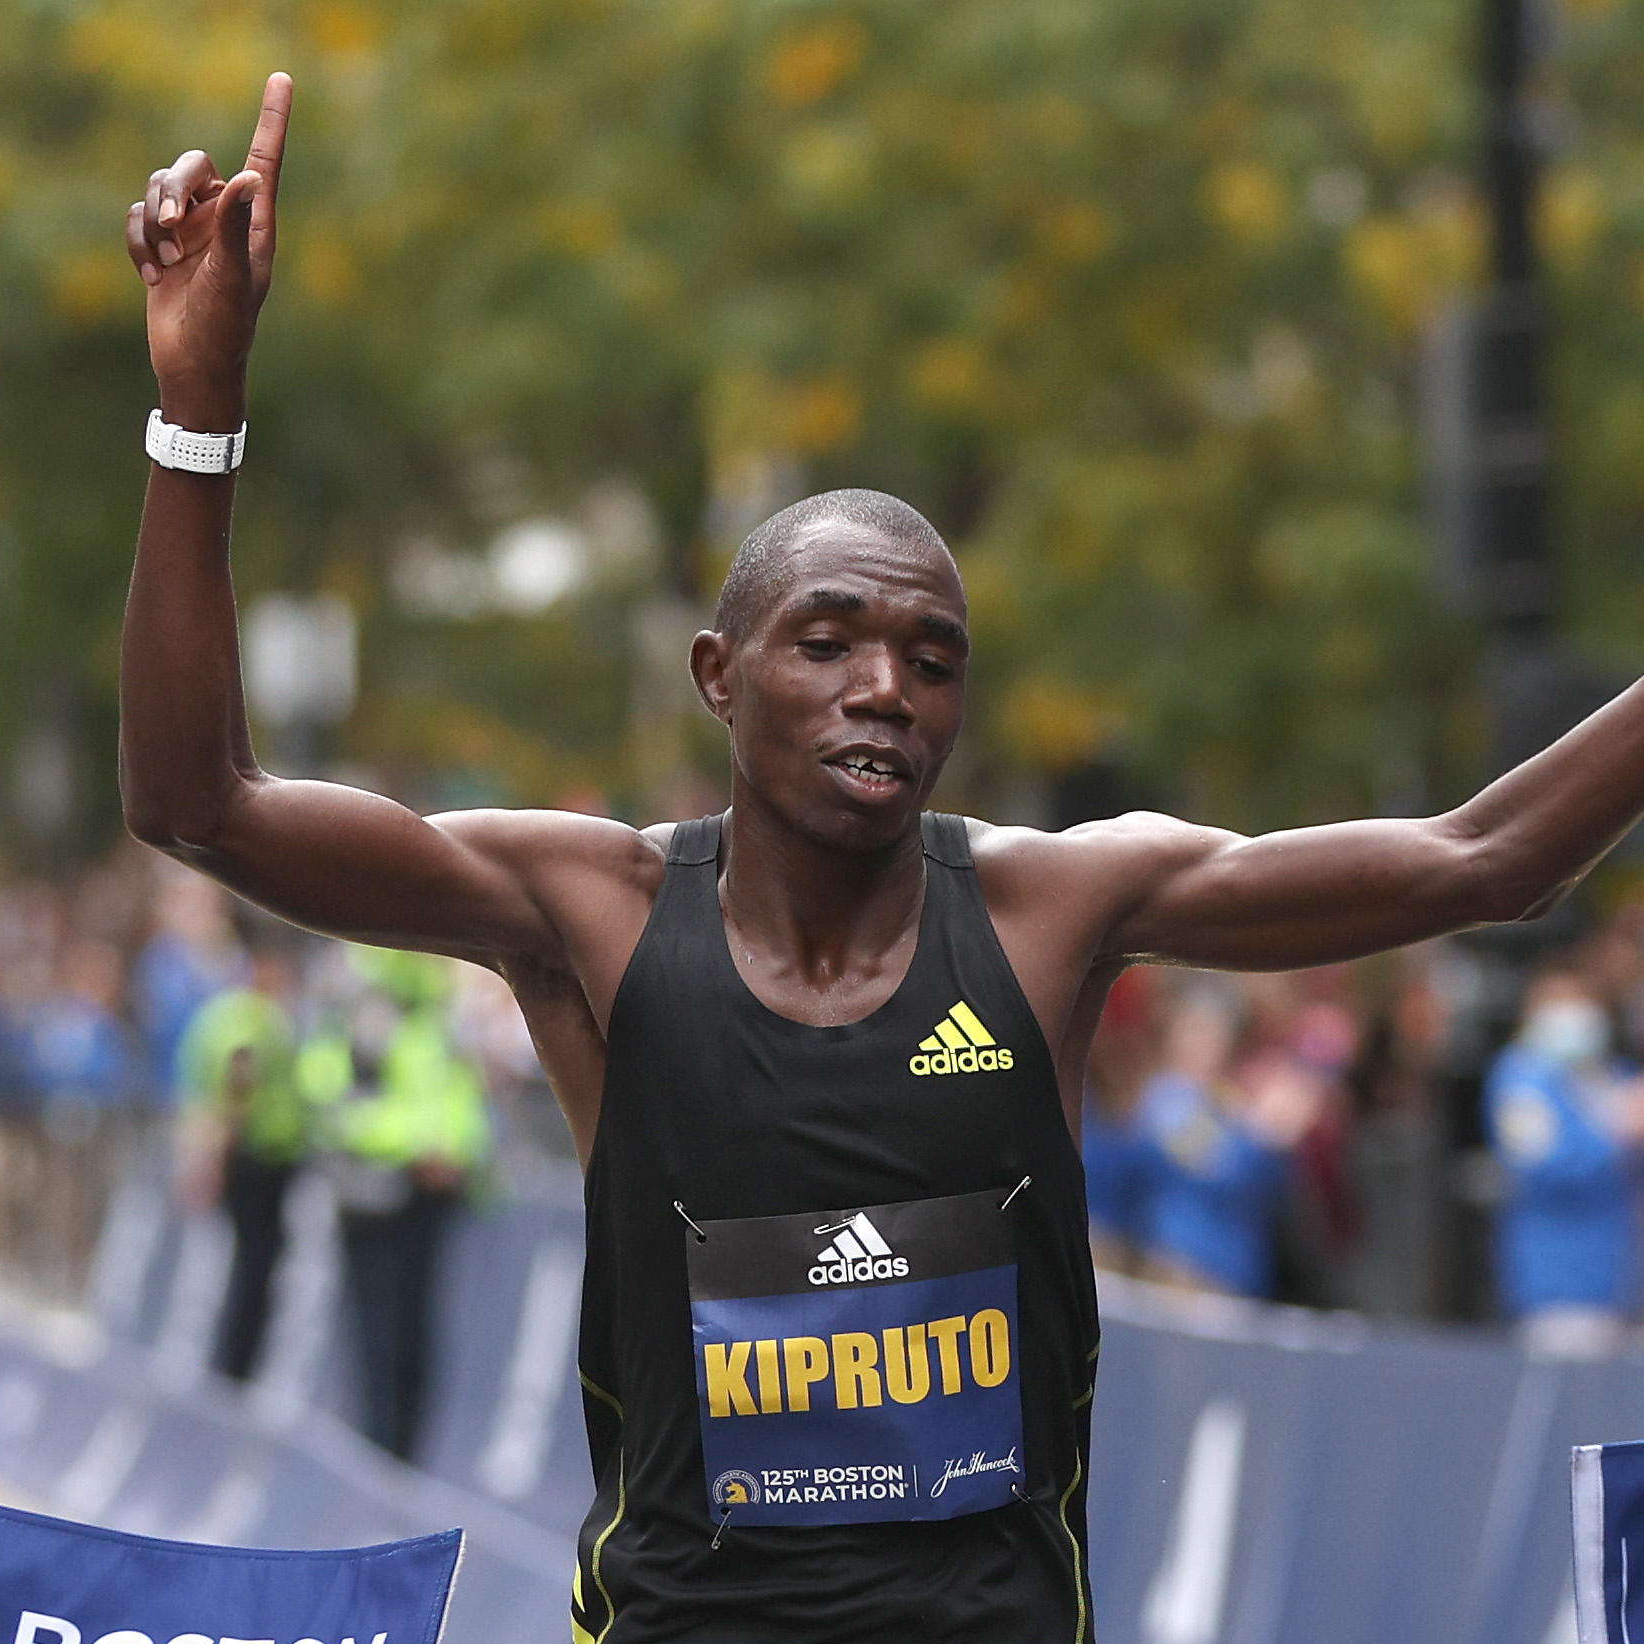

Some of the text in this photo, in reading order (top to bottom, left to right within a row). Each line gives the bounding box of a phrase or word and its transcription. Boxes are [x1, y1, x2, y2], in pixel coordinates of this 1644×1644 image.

[909, 1046, 1015, 1076] adidas
[808, 1256, 910, 1286] adidas
[704, 1308, 1012, 1418] KIPRUTO
[760, 1469, 809, 1487] 125TH
[814, 1465, 904, 1485] BOSTON
[764, 1481, 906, 1505] MARATHON
